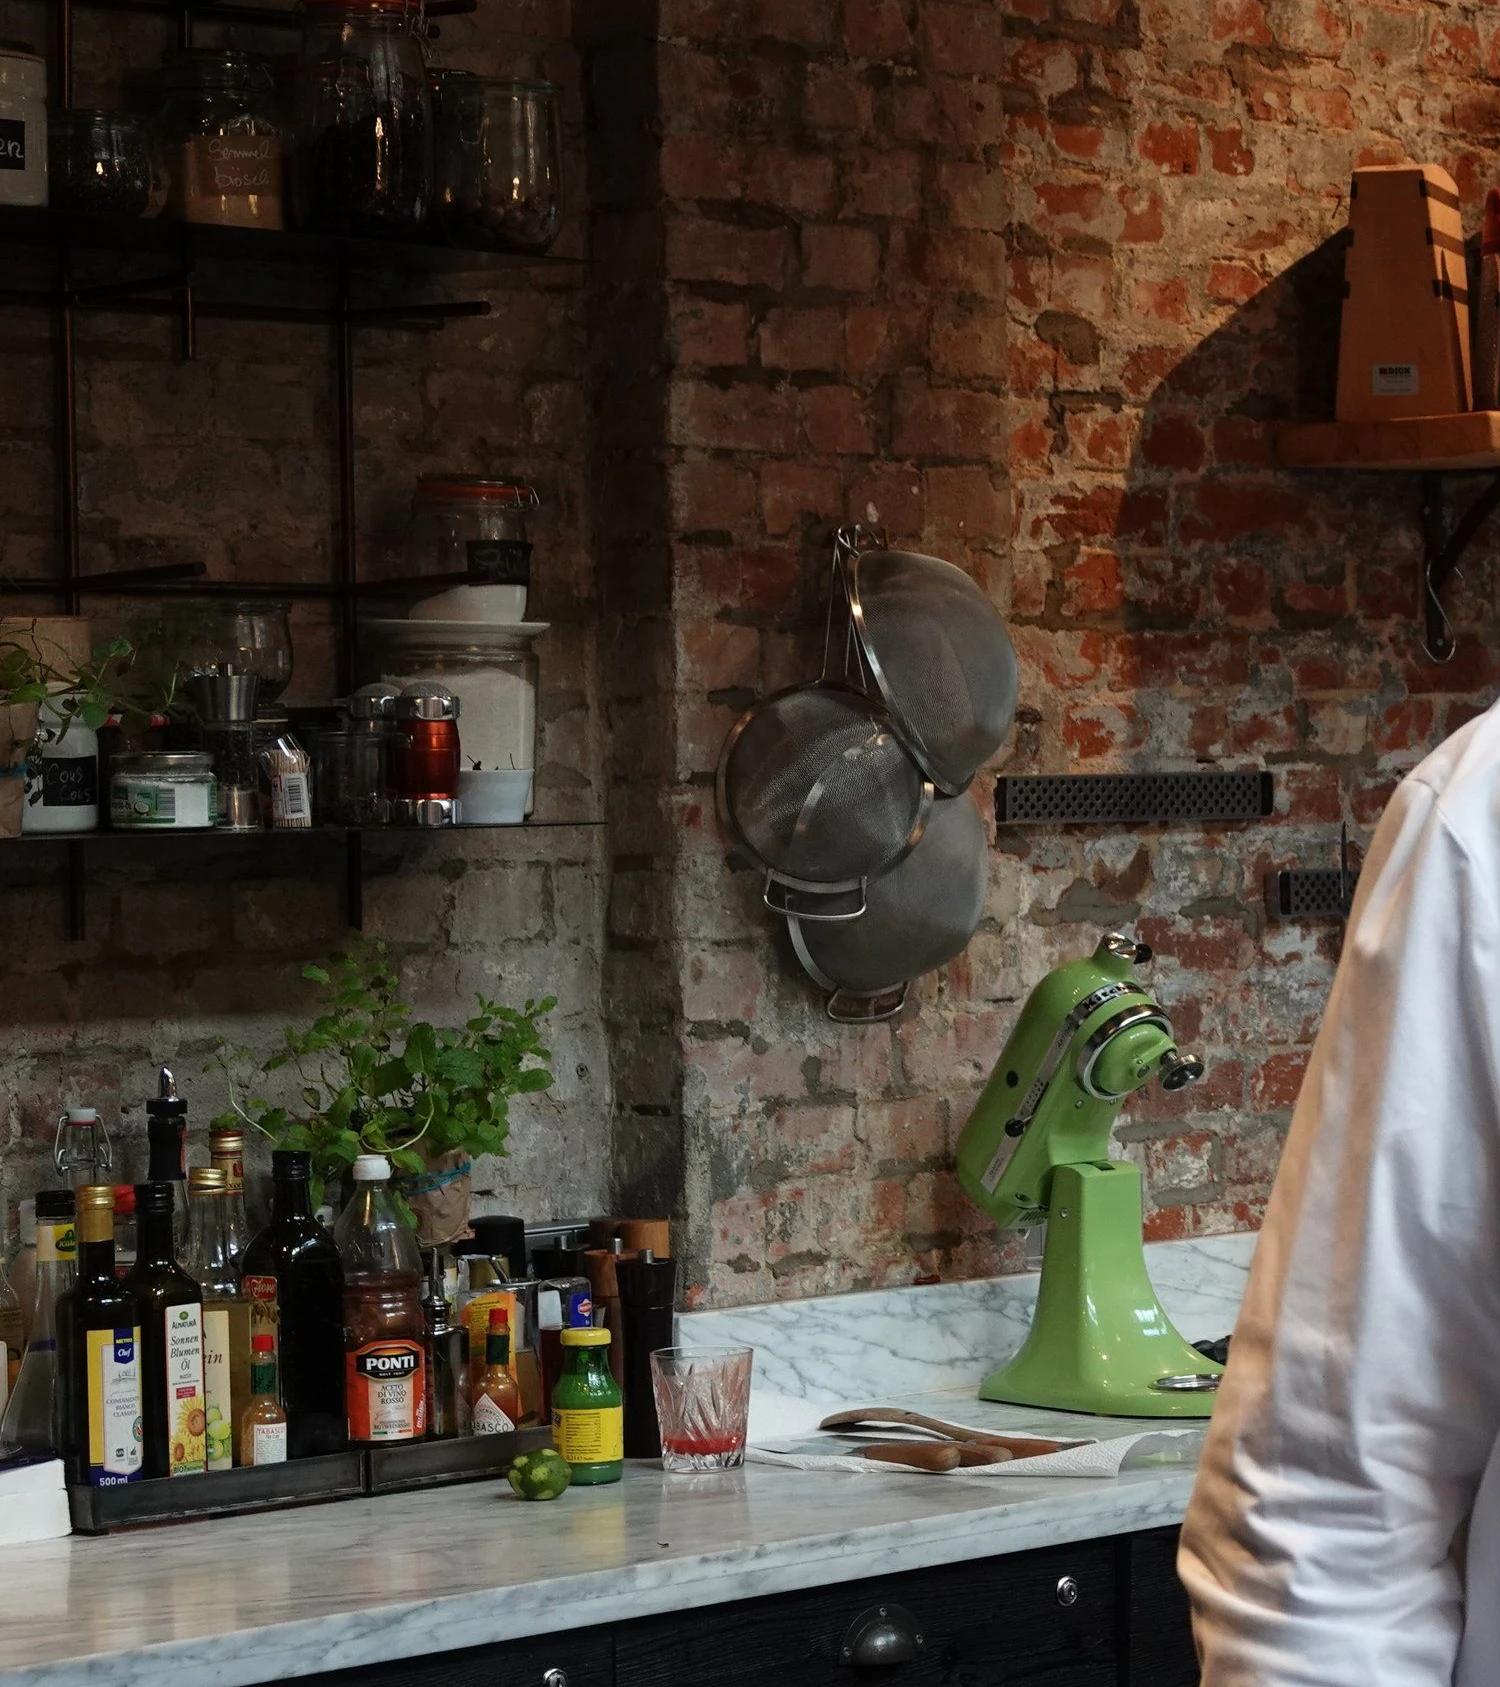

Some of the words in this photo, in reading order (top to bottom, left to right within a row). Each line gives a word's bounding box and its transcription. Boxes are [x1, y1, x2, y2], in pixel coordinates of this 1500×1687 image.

[171, 1335, 199, 1346] Sonnen
[170, 1347, 200, 1359] Blumen
[180, 1357, 191, 1371] Öl
[366, 1355, 415, 1371] PONTI
[381, 1384, 404, 1392] ACETO
[388, 1389, 407, 1398] VINO
[100, 1476, 117, 1487] 500
[117, 1475, 128, 1485] ml
